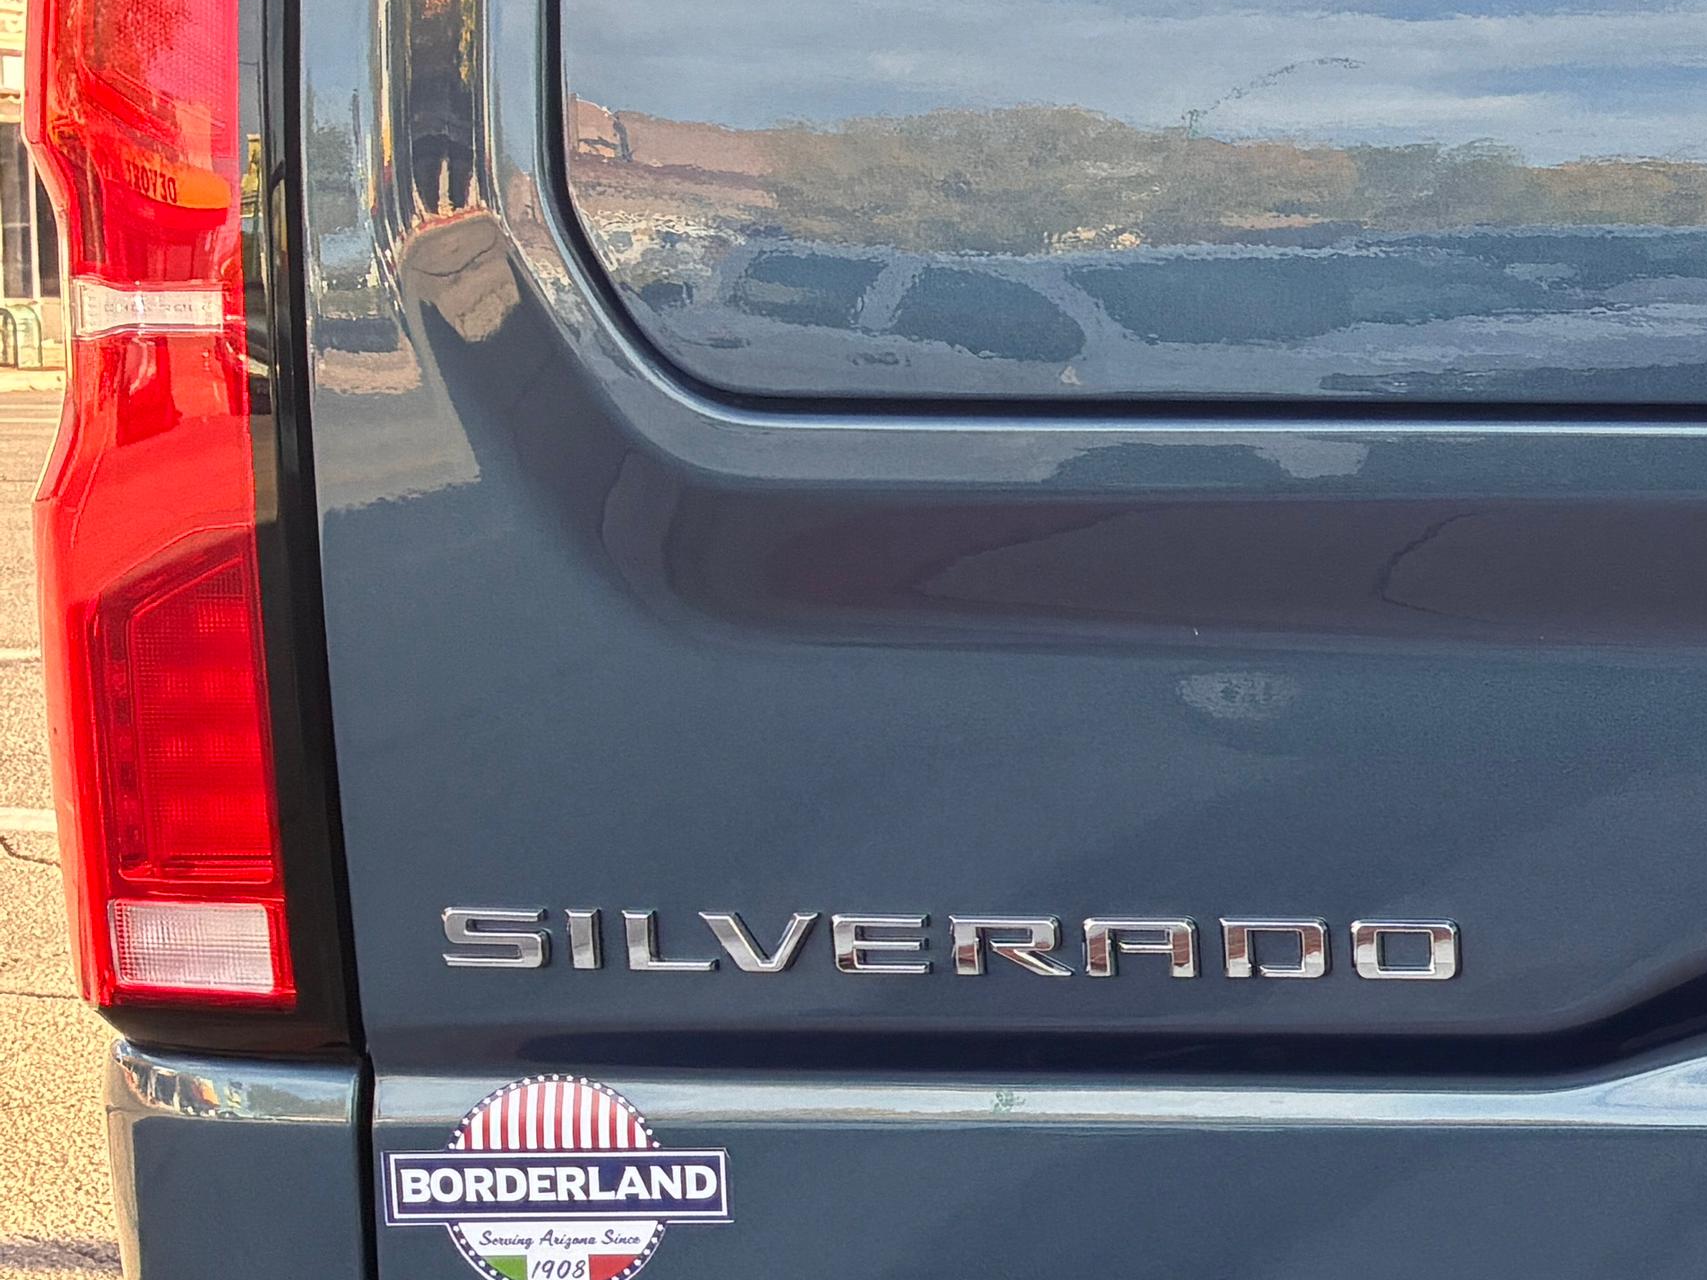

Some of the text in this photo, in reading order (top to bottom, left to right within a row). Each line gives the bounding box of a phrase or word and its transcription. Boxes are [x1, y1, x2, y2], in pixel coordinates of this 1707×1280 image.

[441, 905, 1463, 980] SILVERADO
[400, 1165, 718, 1204] BORDERLAND
[478, 1228, 641, 1250] Serving Arizona Since
[530, 1259, 587, 1280] 1908
